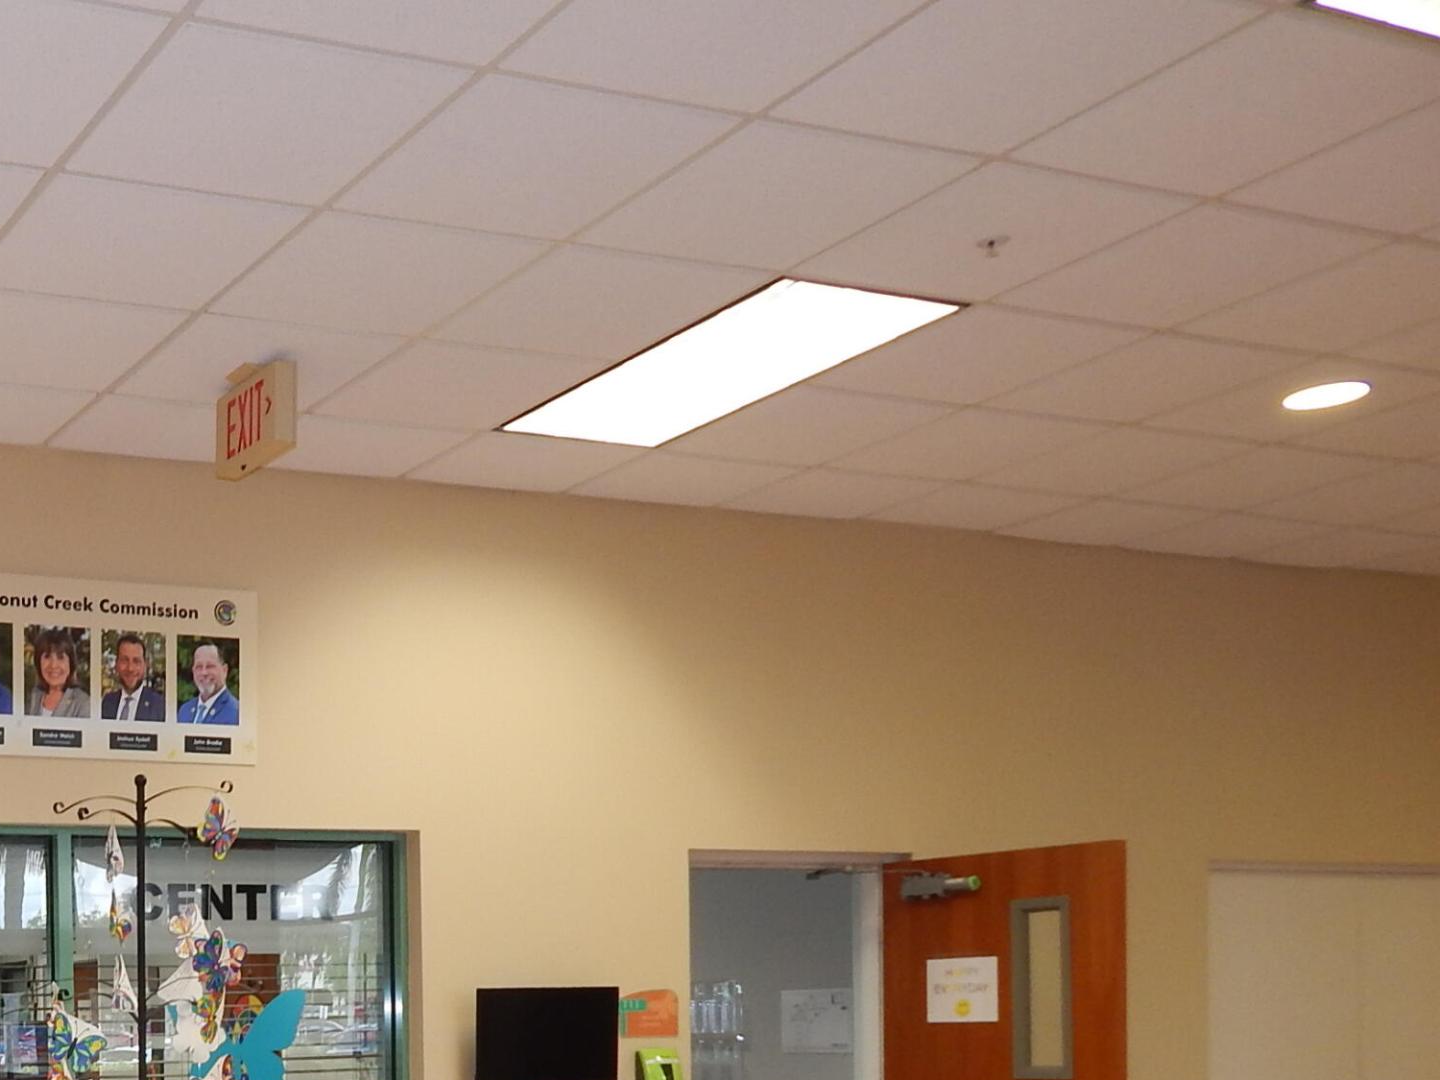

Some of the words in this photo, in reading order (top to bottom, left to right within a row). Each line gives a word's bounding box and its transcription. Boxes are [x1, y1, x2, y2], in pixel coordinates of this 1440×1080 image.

[226, 378, 264, 460] EXIT
[43, 594, 93, 613] Creek
[99, 598, 199, 620] Commission
